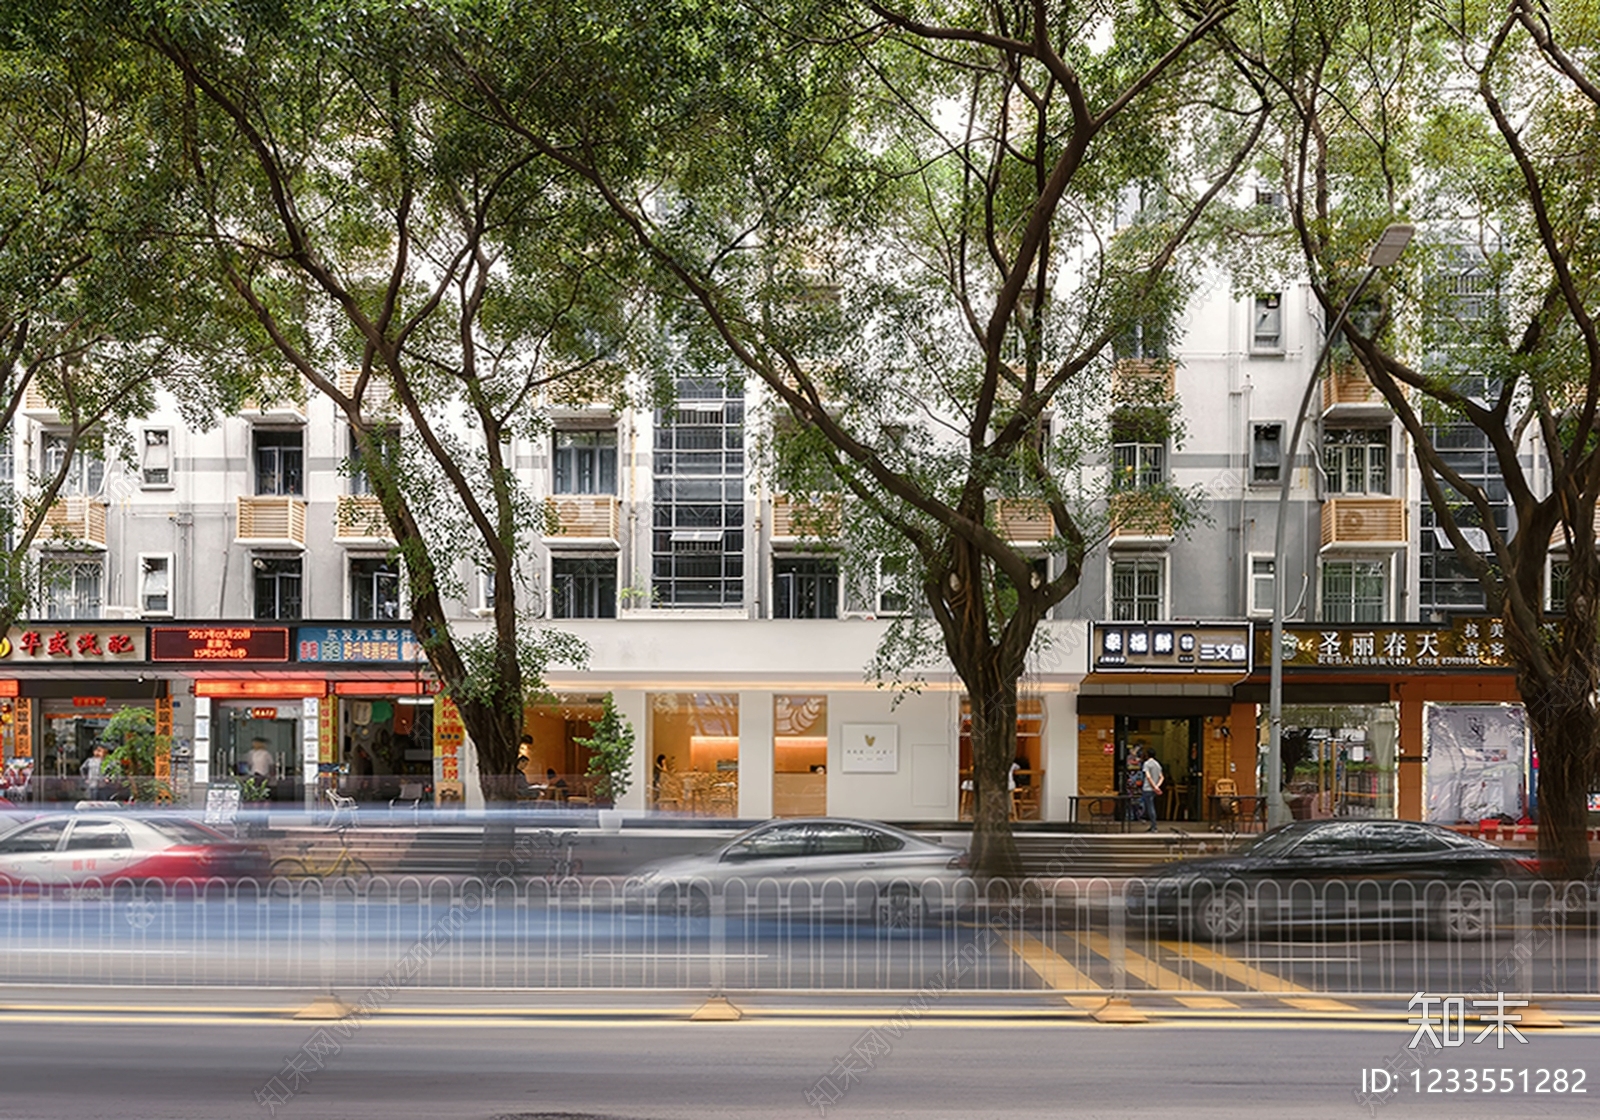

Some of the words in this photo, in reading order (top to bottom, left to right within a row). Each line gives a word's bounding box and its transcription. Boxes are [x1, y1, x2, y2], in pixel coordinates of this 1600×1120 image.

[19, 630, 135, 657] 华盛汽配
[1200, 643, 1247, 661] 三文鱼
[1319, 631, 1440, 657] 圣丽春天
